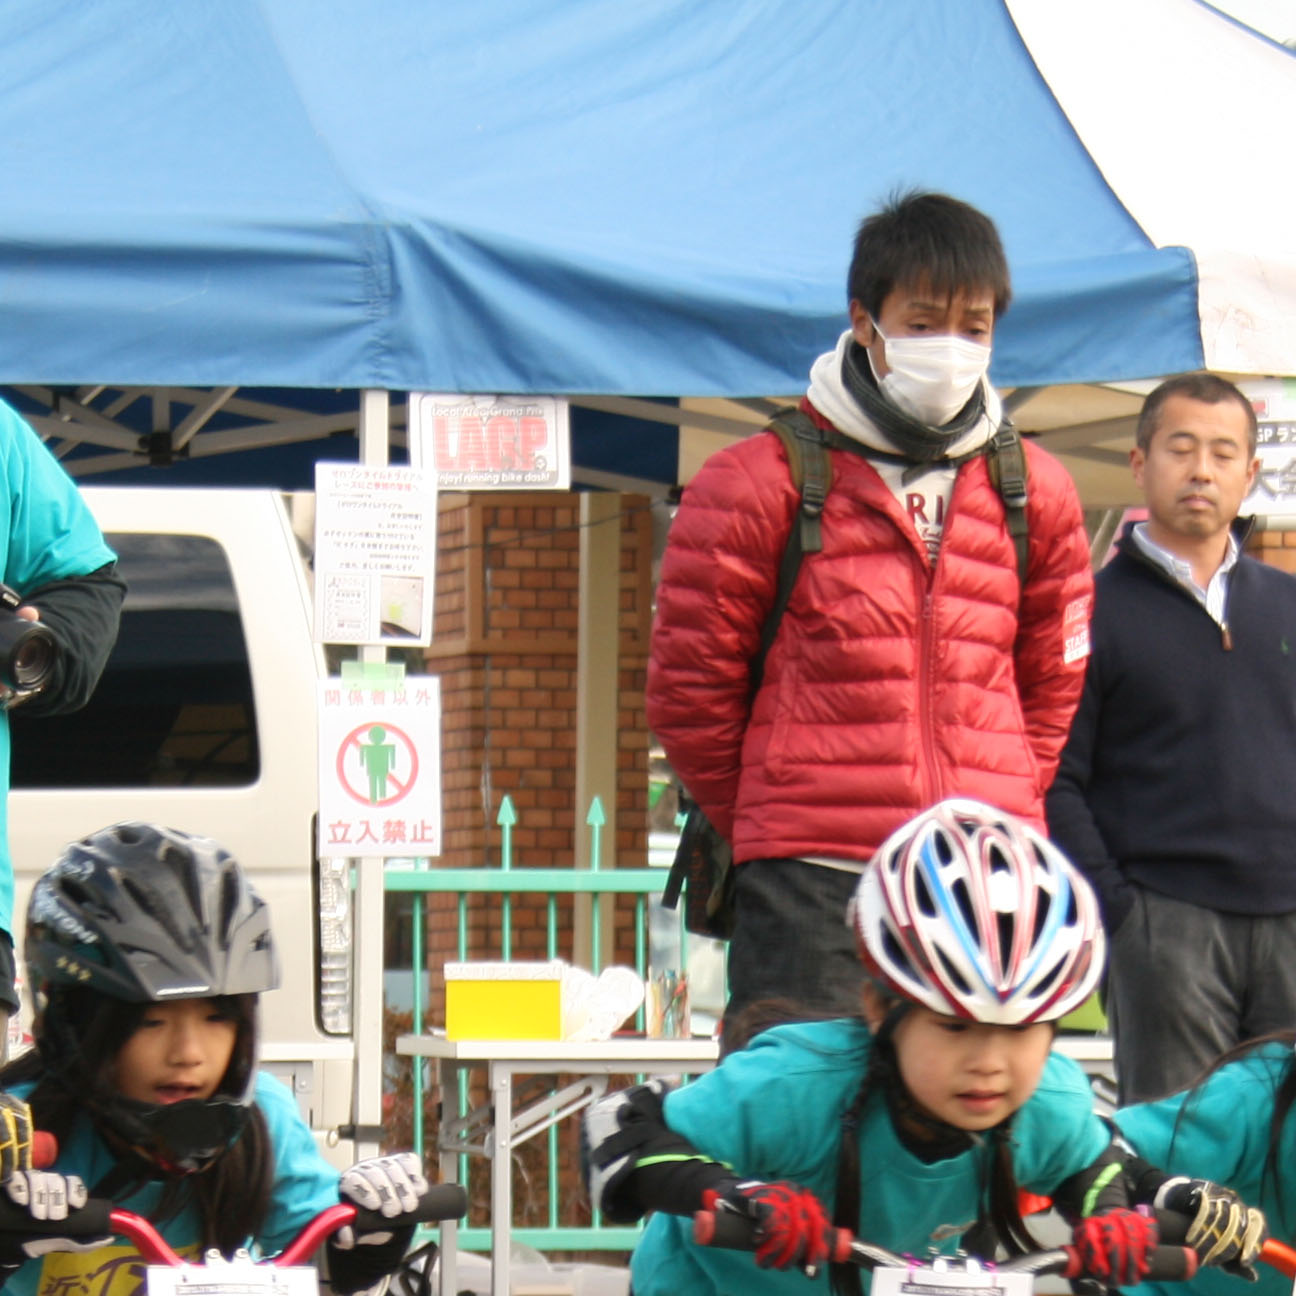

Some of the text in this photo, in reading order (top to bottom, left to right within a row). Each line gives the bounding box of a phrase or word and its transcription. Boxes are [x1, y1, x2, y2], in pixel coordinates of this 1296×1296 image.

[490, 407, 523, 417] Grand
[434, 416, 548, 472] LAGP
[439, 472, 550, 485] njoy! running bike dash!
[324, 688, 431, 707] 関係者以外
[328, 819, 434, 844] 立入禁止
